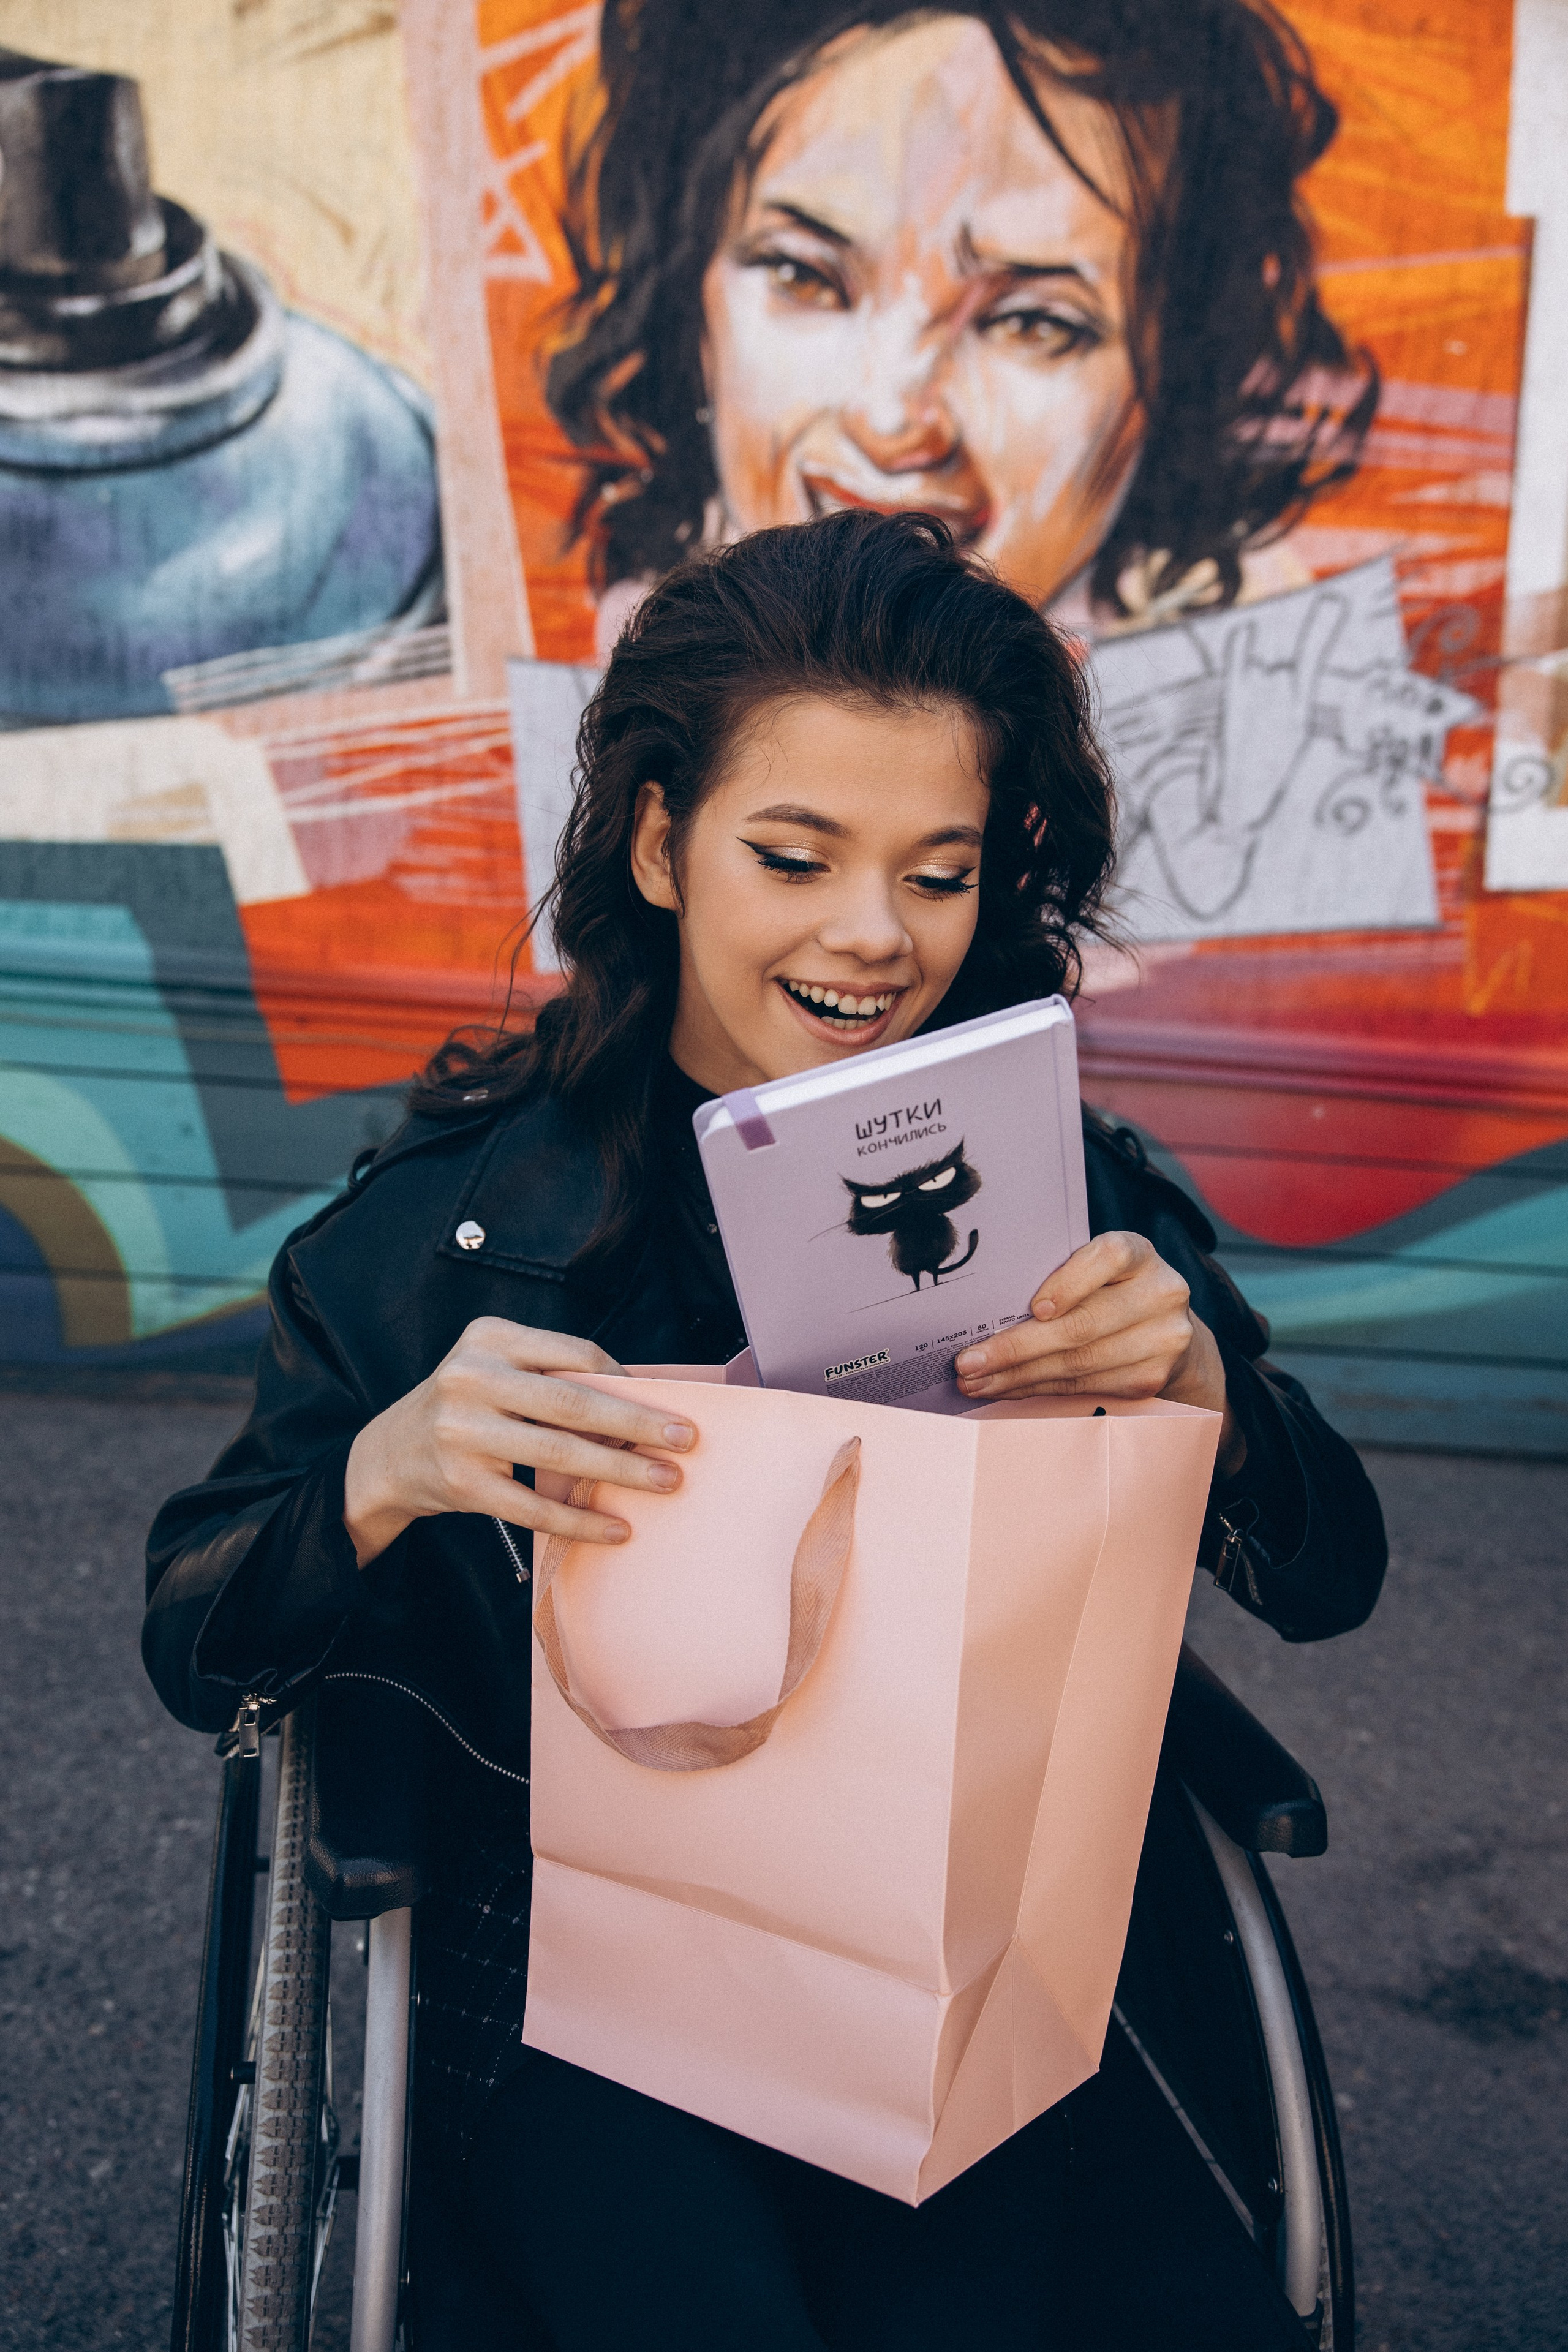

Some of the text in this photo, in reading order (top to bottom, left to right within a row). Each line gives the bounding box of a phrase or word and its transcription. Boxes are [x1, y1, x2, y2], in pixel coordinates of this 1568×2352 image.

[856, 1098, 941, 1140] ШУТКИ
[858, 1123, 947, 1157] КОНЧИЛИСЬ
[914, 1343, 929, 1351] 120
[825, 1351, 888, 1378] FUNSTER
